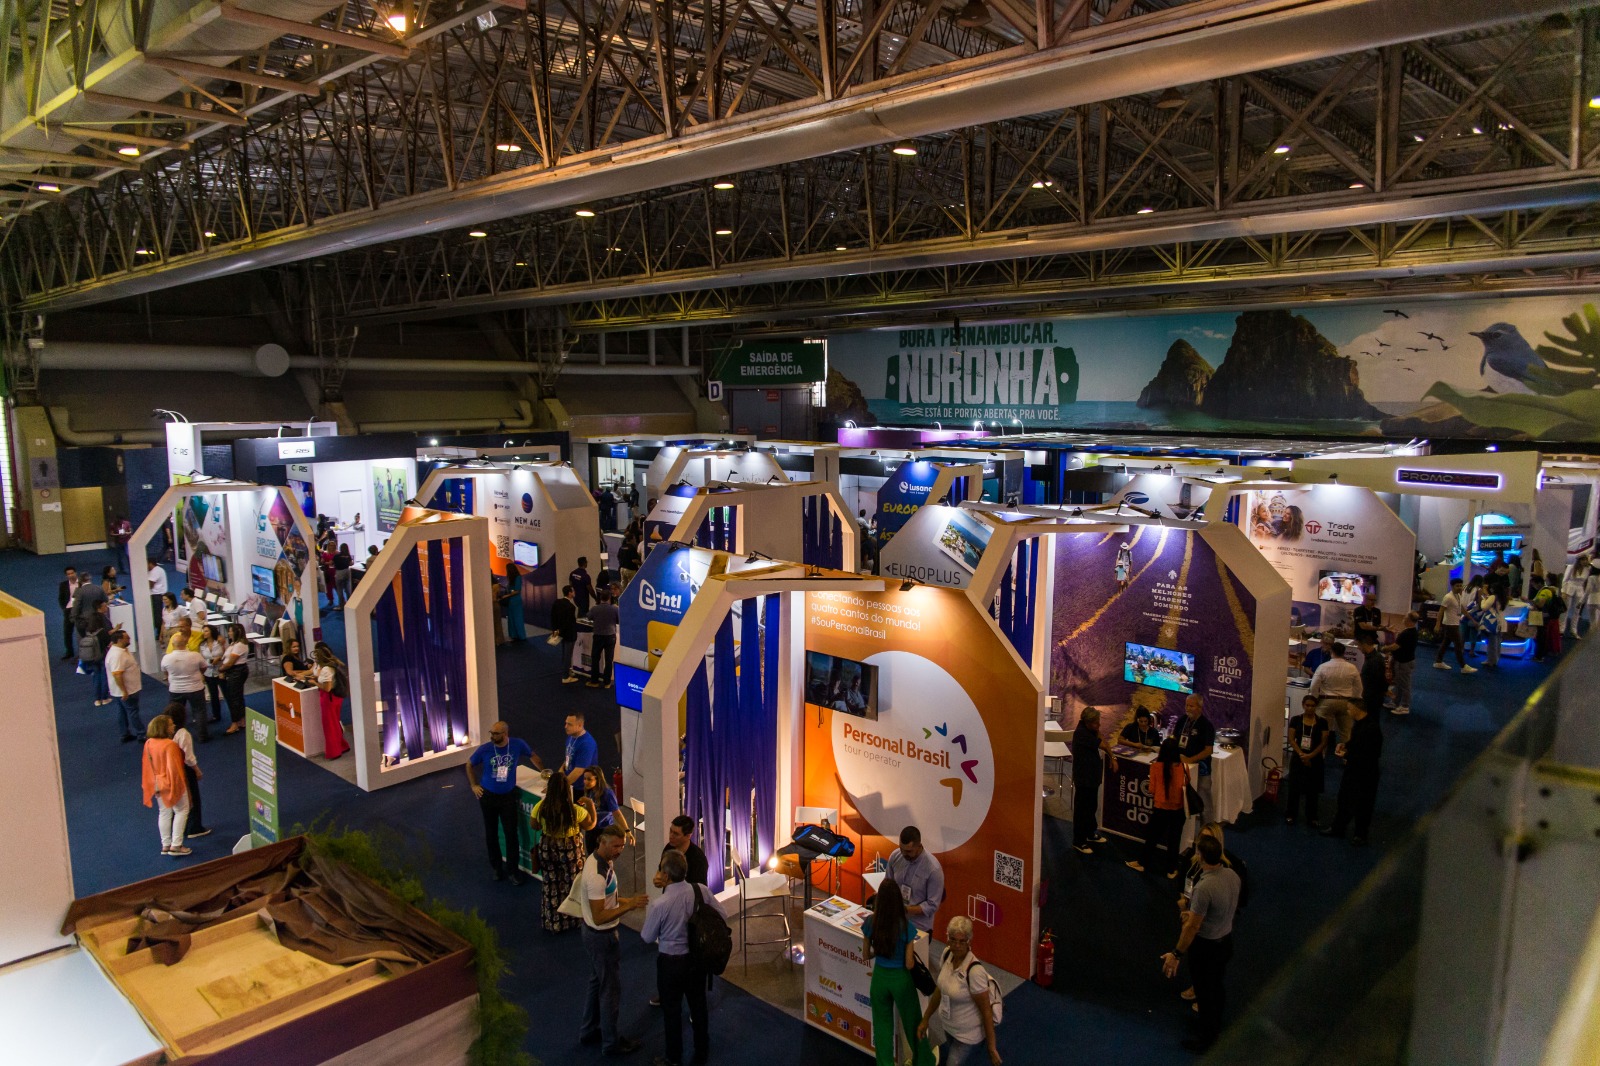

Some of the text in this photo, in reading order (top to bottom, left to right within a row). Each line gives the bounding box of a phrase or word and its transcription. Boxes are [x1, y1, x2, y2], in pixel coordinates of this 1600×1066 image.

[899, 322, 1058, 348] BORA PERNAMBUCAR.
[749, 351, 793, 362] SAÍDA DE
[740, 364, 803, 376] EMERGÊNCIA
[899, 348, 1059, 405] NORONHA
[710, 383, 720, 400] D
[924, 406, 1060, 420] ESTÁ DE PORTAS ABERTAS PRA VOCÊ.
[173, 447, 188, 456] CRIS
[291, 464, 308, 472] CRIS
[514, 516, 528, 526] NEW
[530, 519, 541, 528] AGE
[1327, 521, 1354, 531] Trade
[1326, 529, 1354, 538] Tours
[892, 562, 960, 584] EUROPLUS
[1152, 588, 1192, 598] MELHORES
[1154, 596, 1188, 605] VIAGENS,
[812, 590, 920, 617] Conectando pessoas aos
[1154, 602, 1188, 611] DOMUNDO
[812, 602, 920, 631] quatro cantos do mundo!
[812, 616, 886, 640] #SouPersonalBrasil
[844, 722, 951, 769] Personal Brasil
[844, 744, 902, 768] tour operator
[1126, 792, 1153, 809] mu
[818, 938, 850, 959] Personal
[850, 952, 872, 968] Brasil
